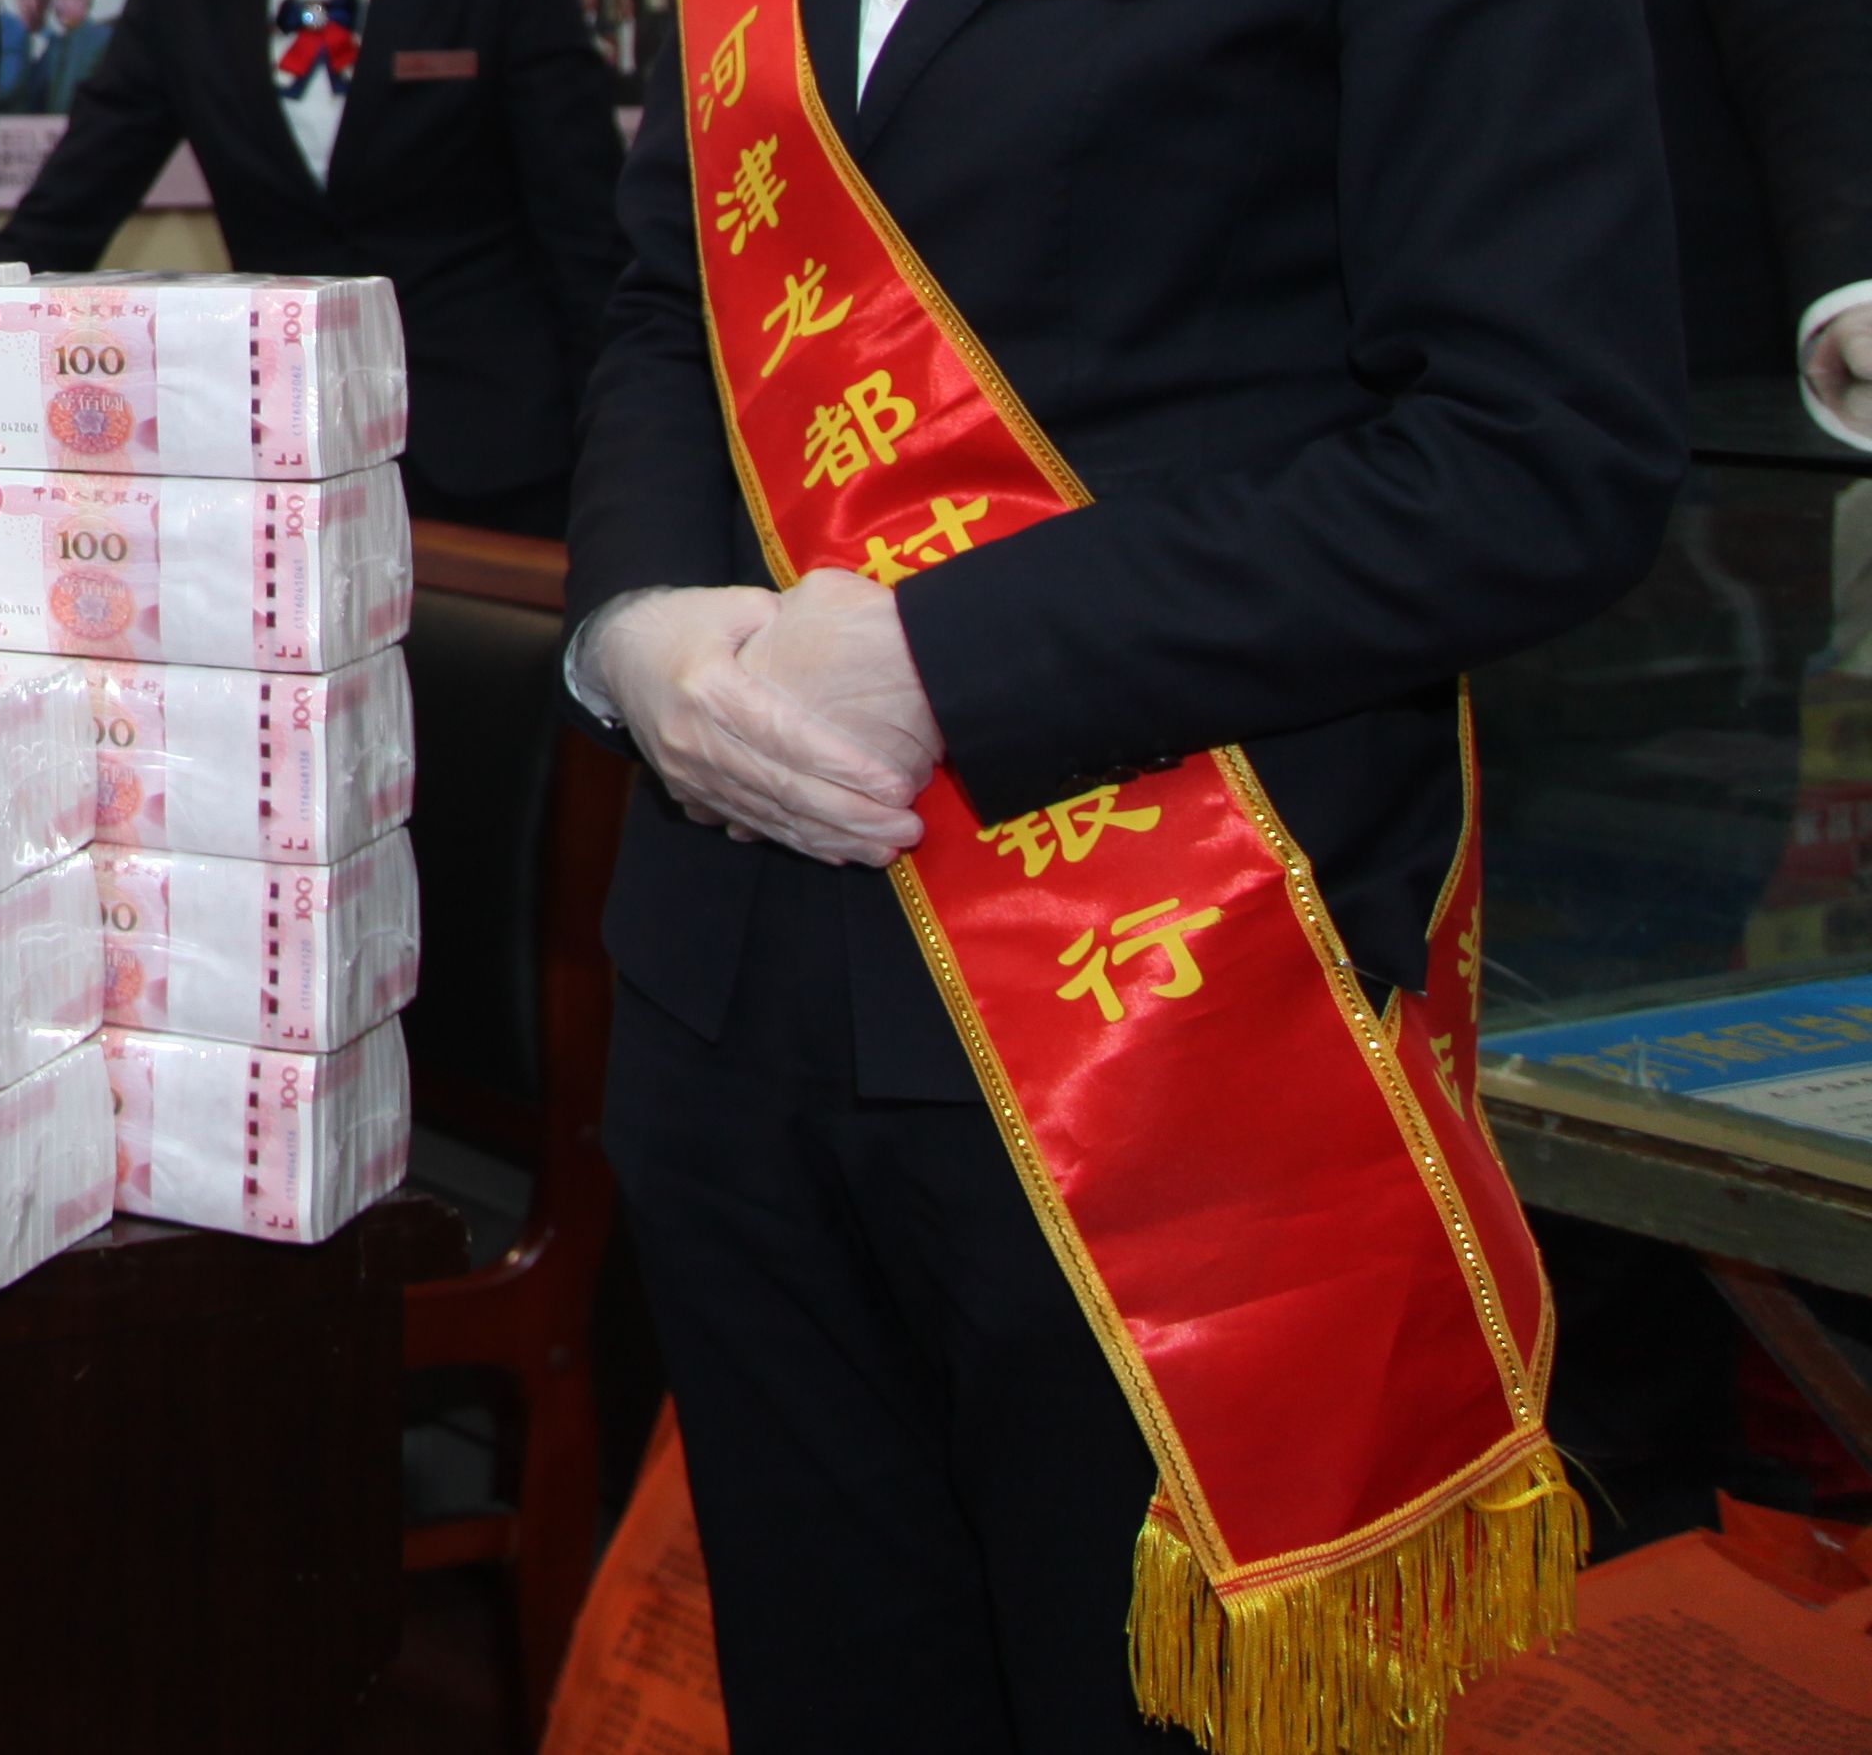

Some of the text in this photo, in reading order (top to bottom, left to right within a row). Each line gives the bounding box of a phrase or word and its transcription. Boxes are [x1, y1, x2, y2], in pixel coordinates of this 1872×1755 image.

[283, 301, 302, 347] 100
[55, 345, 126, 376] 100
[286, 494, 305, 540] 100
[57, 530, 129, 563] 100
[292, 686, 312, 732] 100
[294, 876, 313, 922] 100
[281, 1066, 299, 1112] 100
